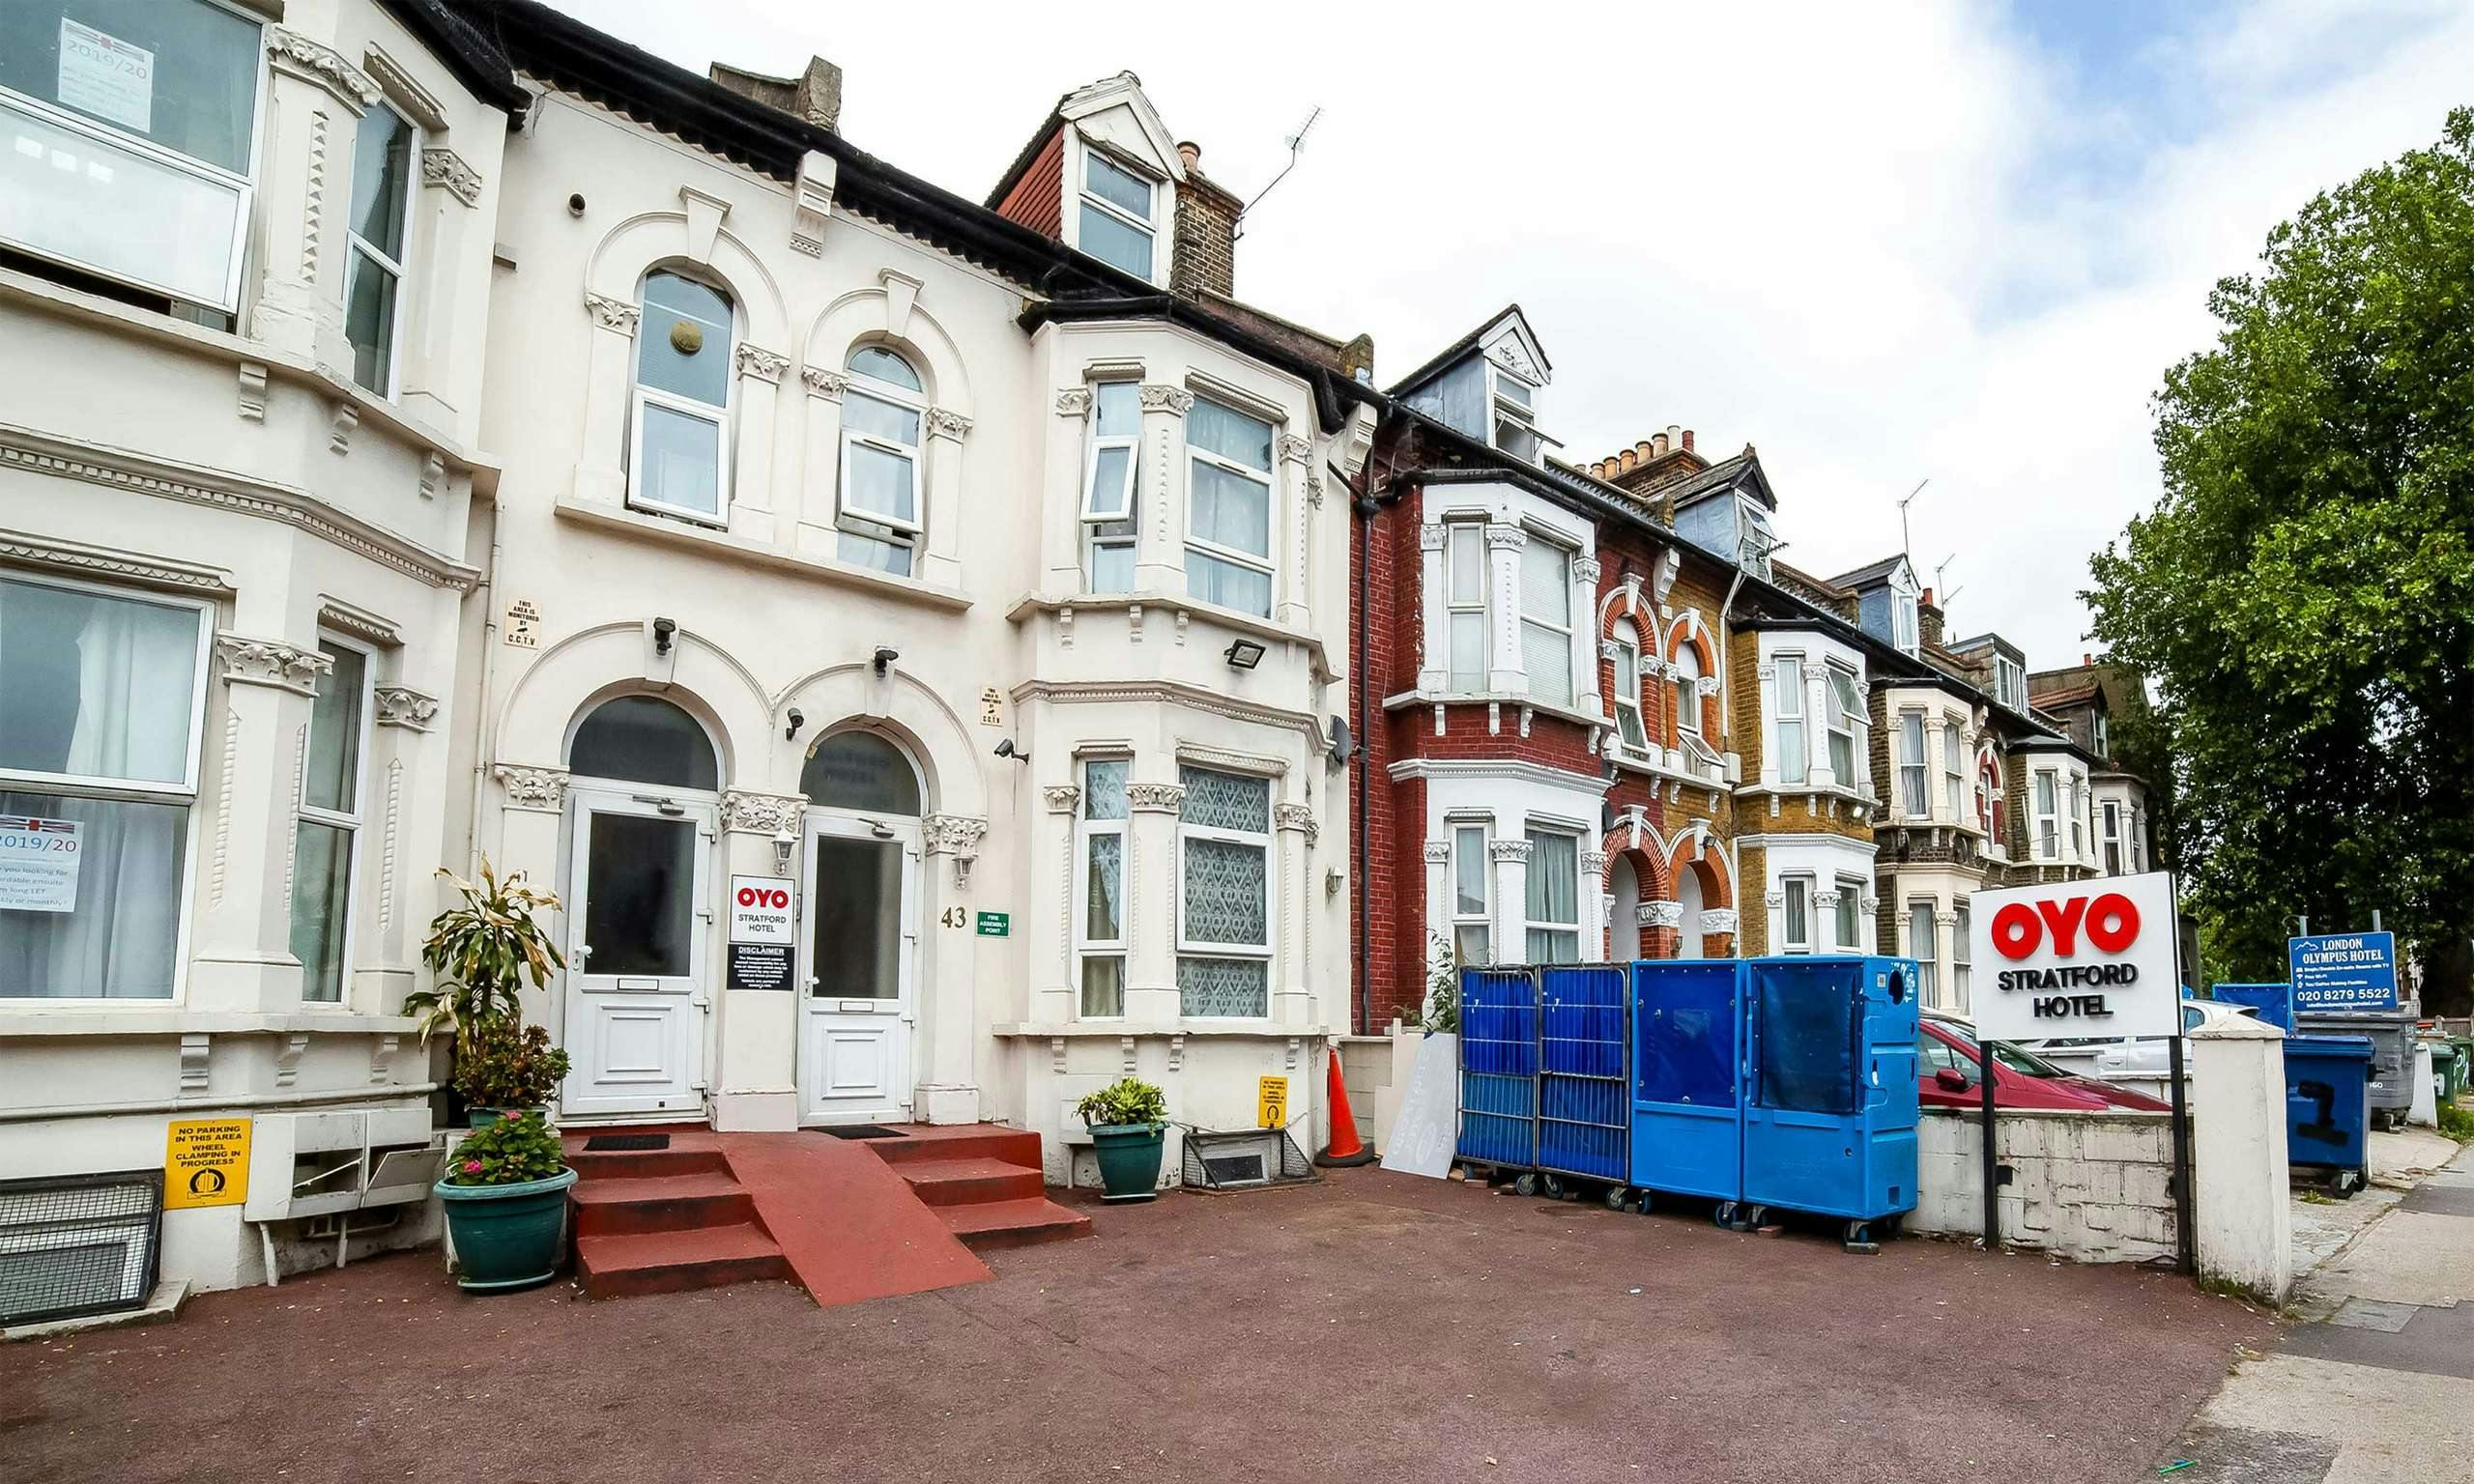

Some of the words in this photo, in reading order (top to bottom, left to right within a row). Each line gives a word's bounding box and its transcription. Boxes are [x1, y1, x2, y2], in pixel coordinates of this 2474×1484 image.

[68, 40, 147, 79] 2019/20
[0, 835, 76, 852] 019/20
[737, 888, 789, 909] OYO
[738, 914, 787, 924] STRATFORD
[941, 906, 966, 928] 43
[749, 924, 776, 932] HOTEL
[1991, 893, 2142, 960] OYO
[738, 946, 785, 956] DISCLAIMER
[2322, 938, 2363, 951] LONDON
[2303, 951, 2348, 964] OLYMPUS
[2349, 950, 2384, 961] HOTEL
[1999, 963, 2138, 991] STRATFORD
[2297, 991, 2320, 1001] 020
[2323, 989, 2354, 1000] 8279
[2358, 988, 2391, 999] 5522
[2034, 994, 2114, 1018] HOTEL
[176, 1152, 227, 1160] CLAMPING
[181, 1158, 234, 1167] PROGRESS
